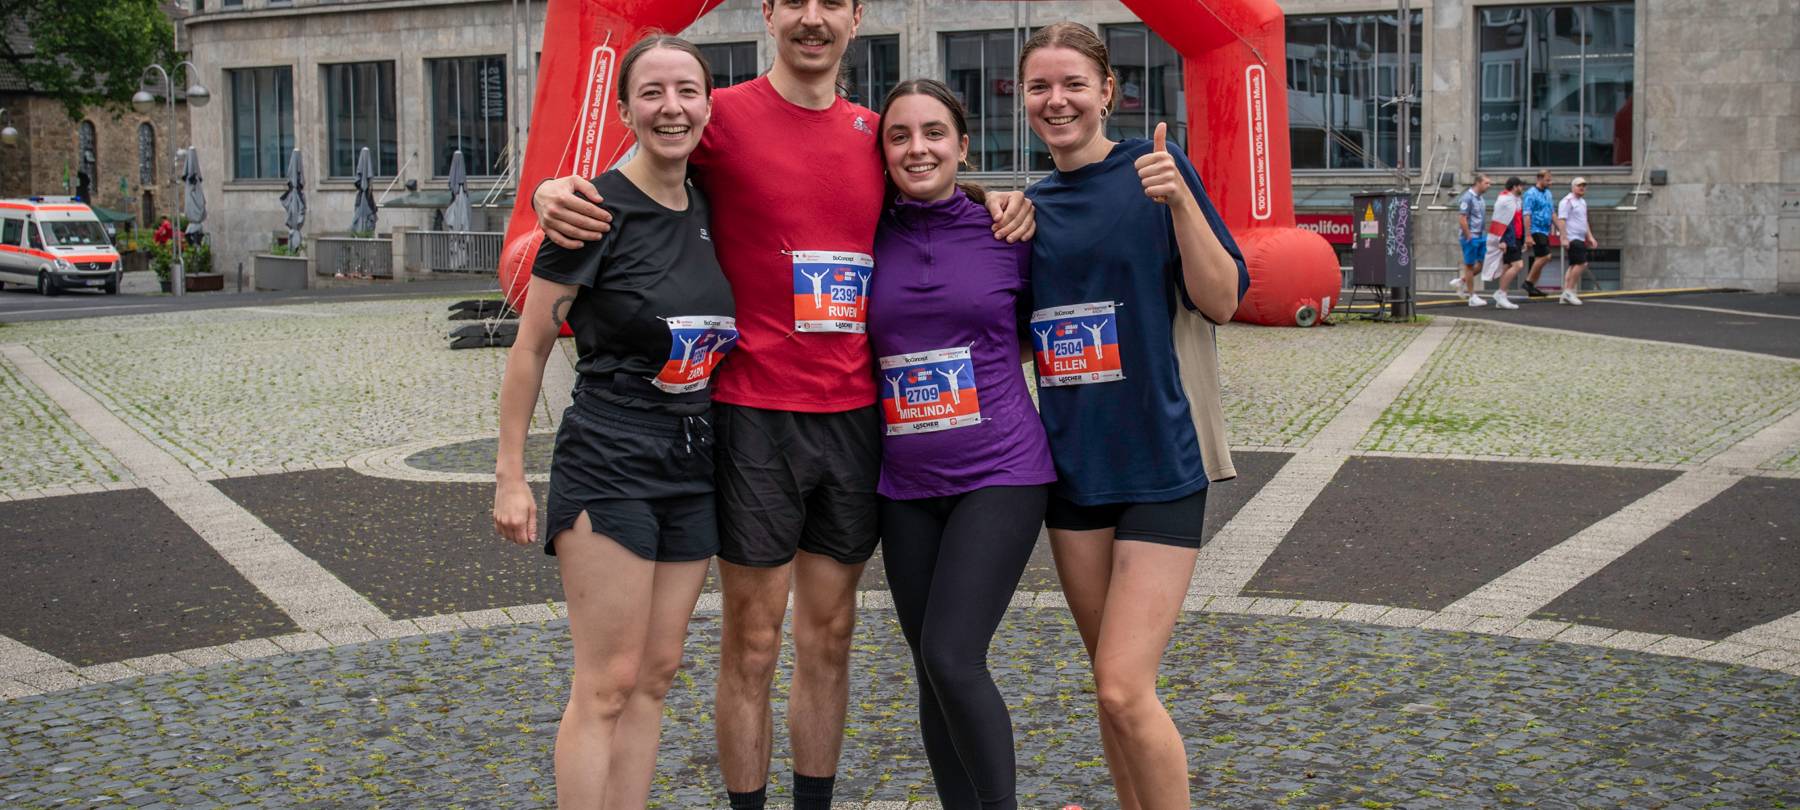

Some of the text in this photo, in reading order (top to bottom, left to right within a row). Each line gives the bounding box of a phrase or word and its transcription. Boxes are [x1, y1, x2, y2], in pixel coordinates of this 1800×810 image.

[1252, 74, 1261, 98] Musik.
[582, 56, 608, 178] von hier. 100% die beste Musik.
[1254, 99, 1263, 121] beste
[1255, 122, 1263, 133] die
[1256, 133, 1264, 156] 100%
[1256, 156, 1264, 173] hier.
[1258, 188, 1266, 210] 100%
[1296, 220, 1350, 234] mplifon
[832, 288, 856, 302] 2392
[1055, 341, 1082, 356] 2504
[687, 366, 704, 380] ZARA
[1054, 359, 1087, 372] ELLEN
[907, 387, 938, 404] 2709
[900, 403, 955, 419] MIRLINDA
